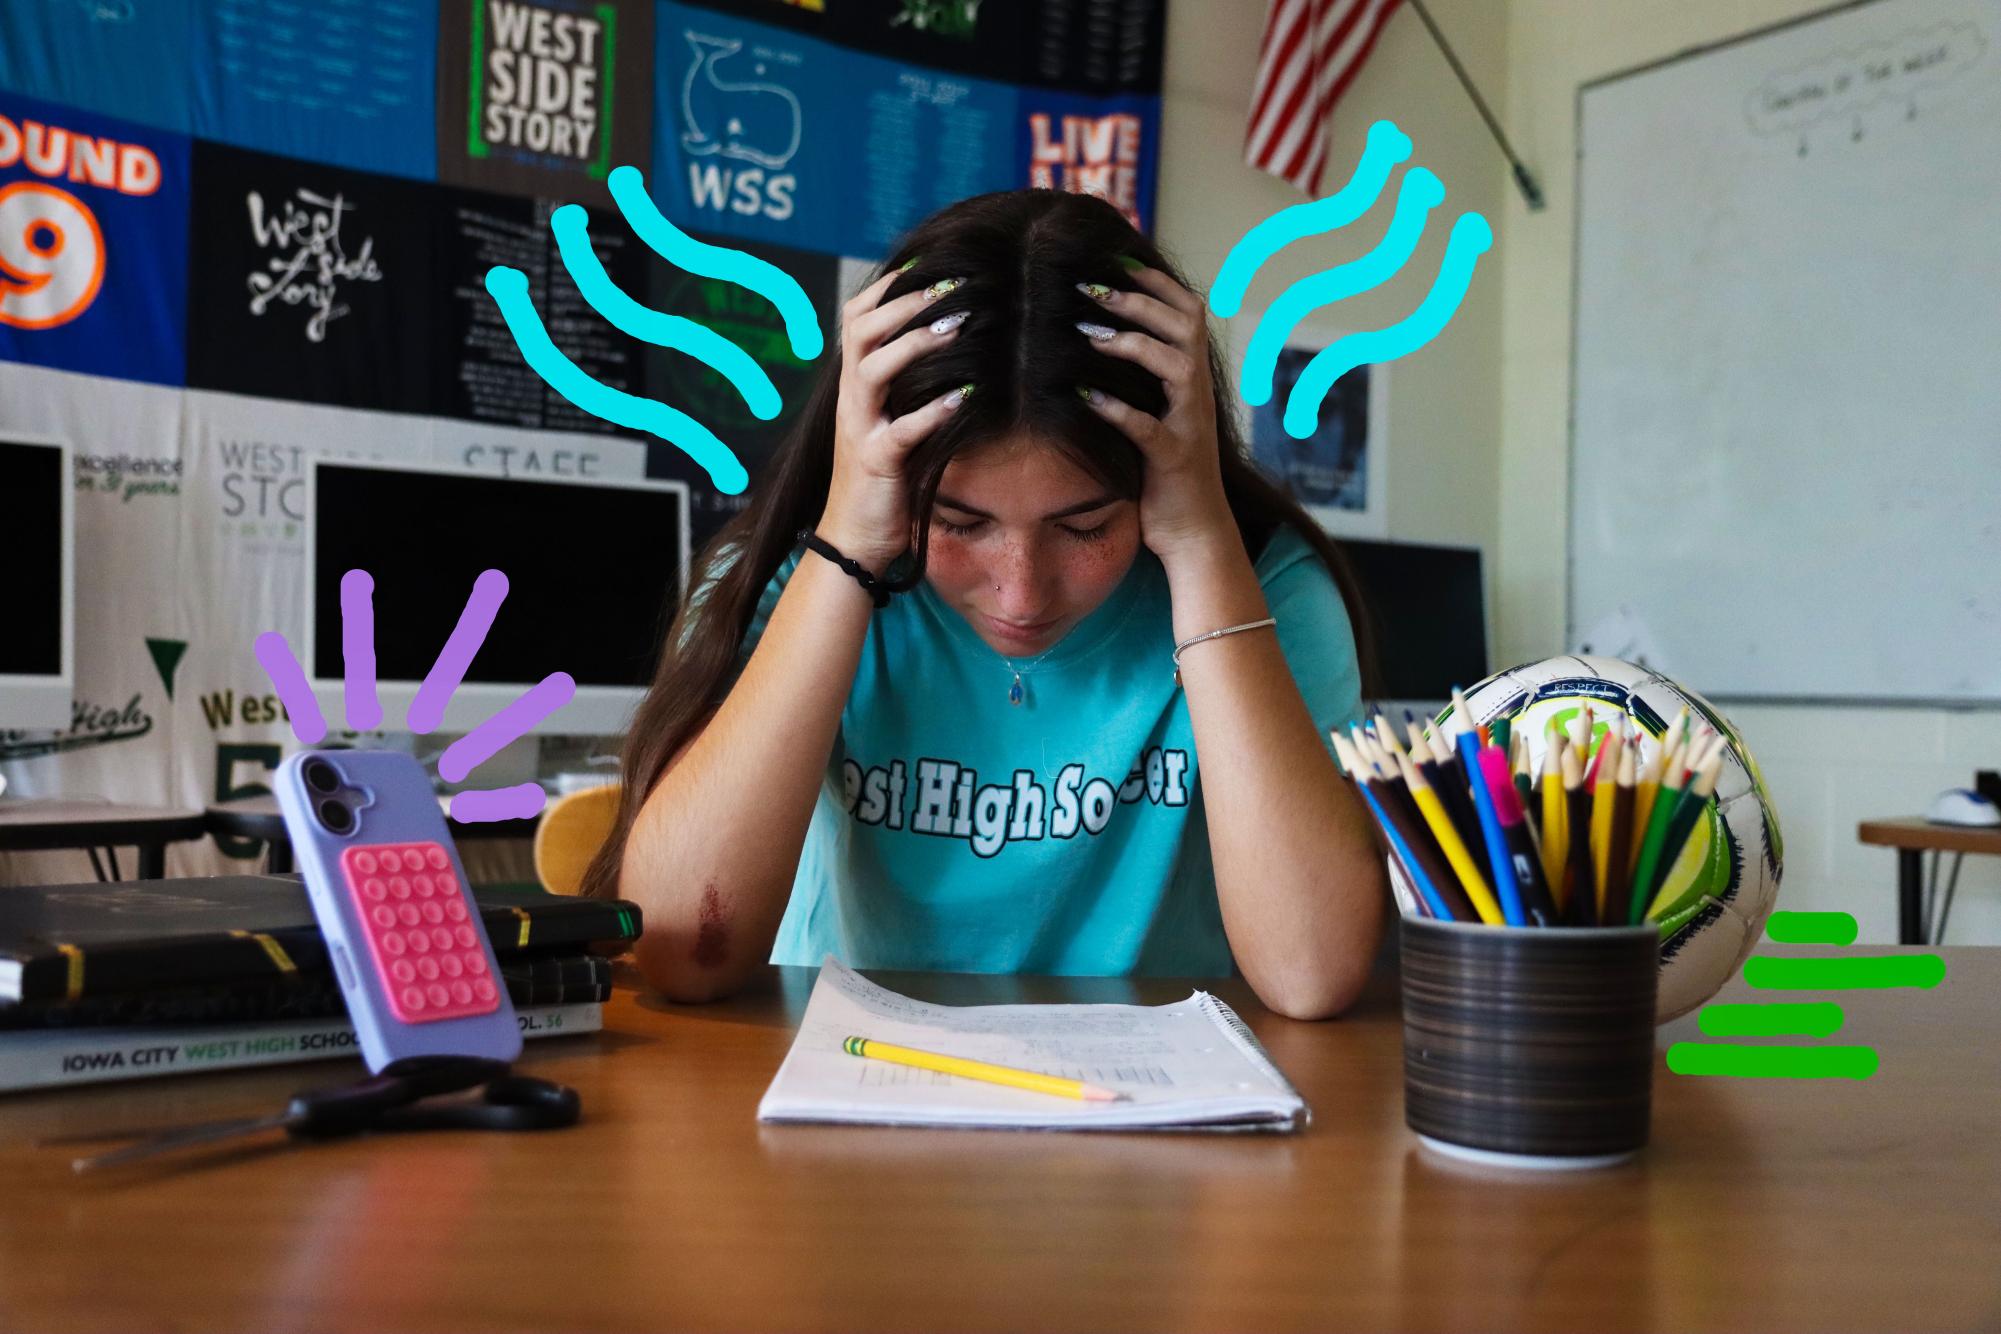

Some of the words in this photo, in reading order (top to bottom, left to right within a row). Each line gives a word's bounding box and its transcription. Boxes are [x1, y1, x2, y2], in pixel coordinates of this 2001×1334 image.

[490, 0, 599, 65] WEST
[489, 50, 596, 121] SIDE
[486, 102, 595, 160] STORY
[1030, 113, 1141, 164] LIVE
[689, 162, 797, 221] WSS
[219, 440, 303, 474] WEST
[222, 472, 305, 521] STO
[1553, 683, 1611, 693] RESPECT
[843, 758, 907, 830] est
[911, 758, 1047, 858] High
[1049, 746, 1190, 840] Socer
[62, 1051, 125, 1073] IOWA
[131, 1046, 179, 1065] CITY
[184, 1040, 241, 1059] WEST
[246, 1037, 295, 1053] HIGH
[300, 1031, 360, 1050] SCHO
[517, 1016, 542, 1031] OL.
